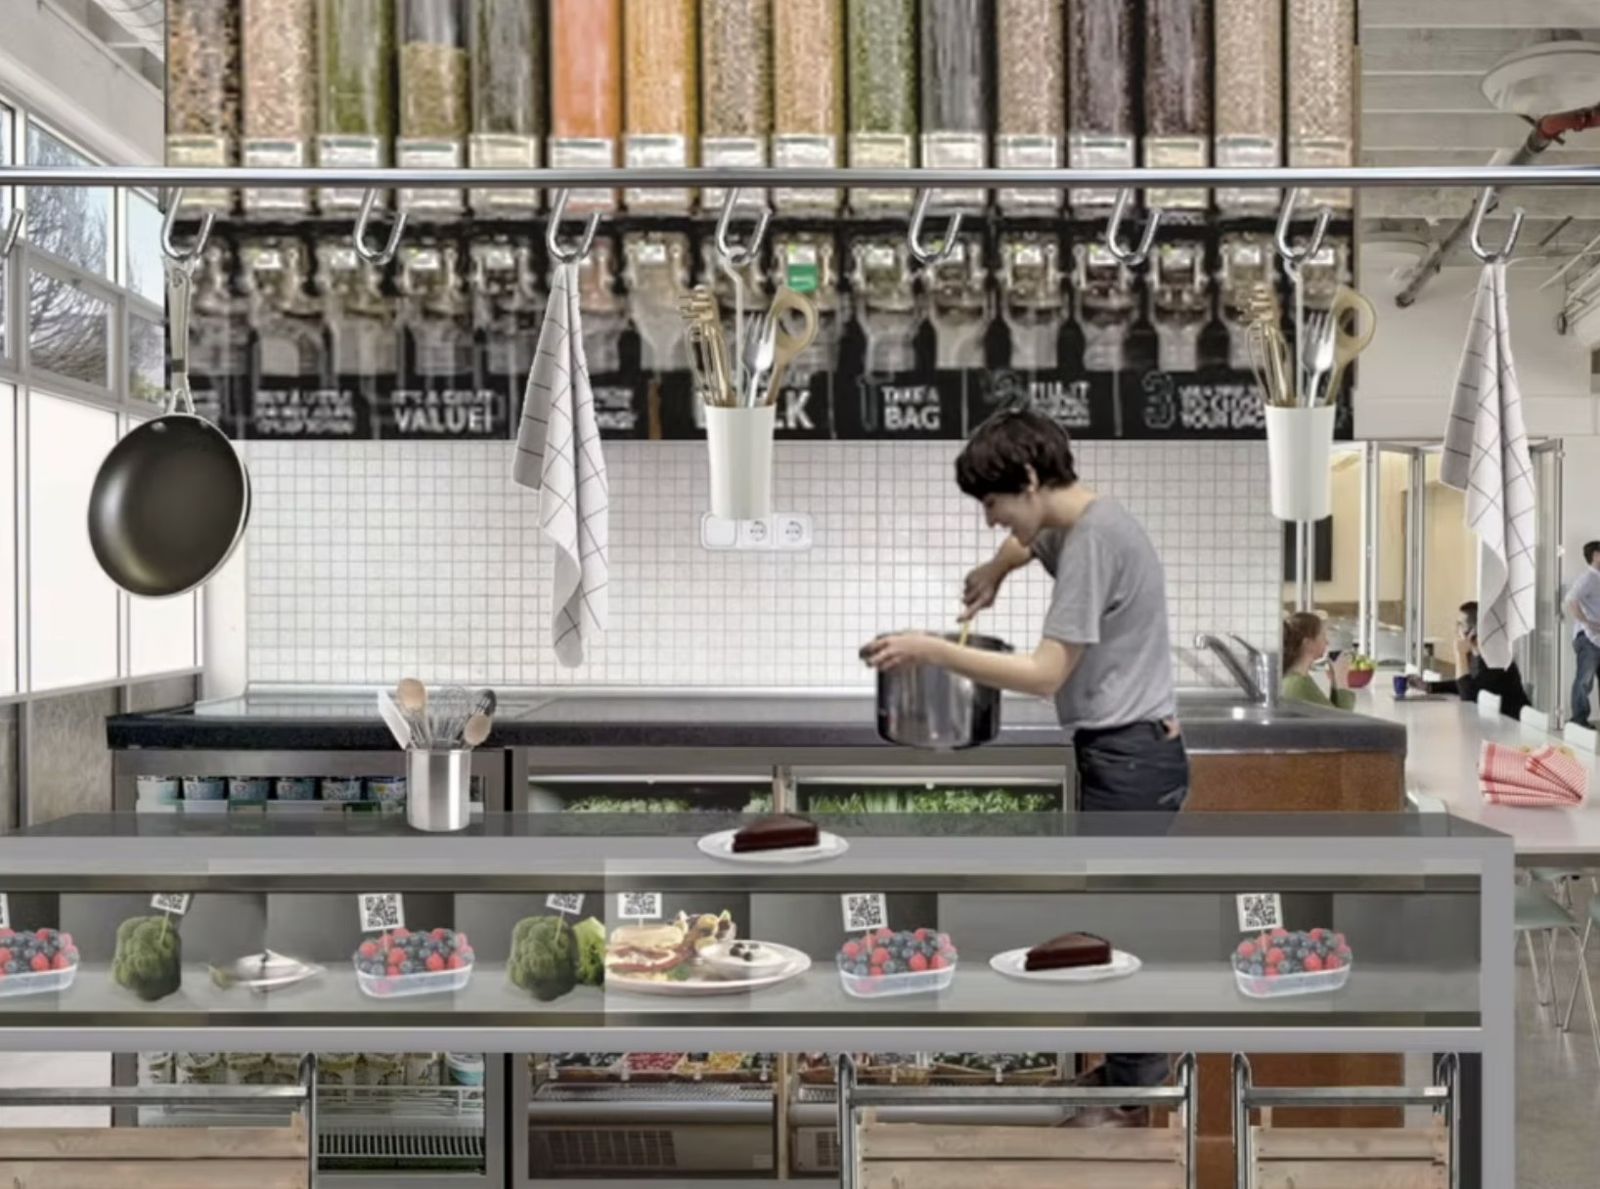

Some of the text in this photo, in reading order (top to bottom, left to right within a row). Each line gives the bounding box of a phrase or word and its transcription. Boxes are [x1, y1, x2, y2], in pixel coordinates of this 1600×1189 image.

[881, 385, 939, 403] TAKE A
[884, 406, 941, 431] BAG
